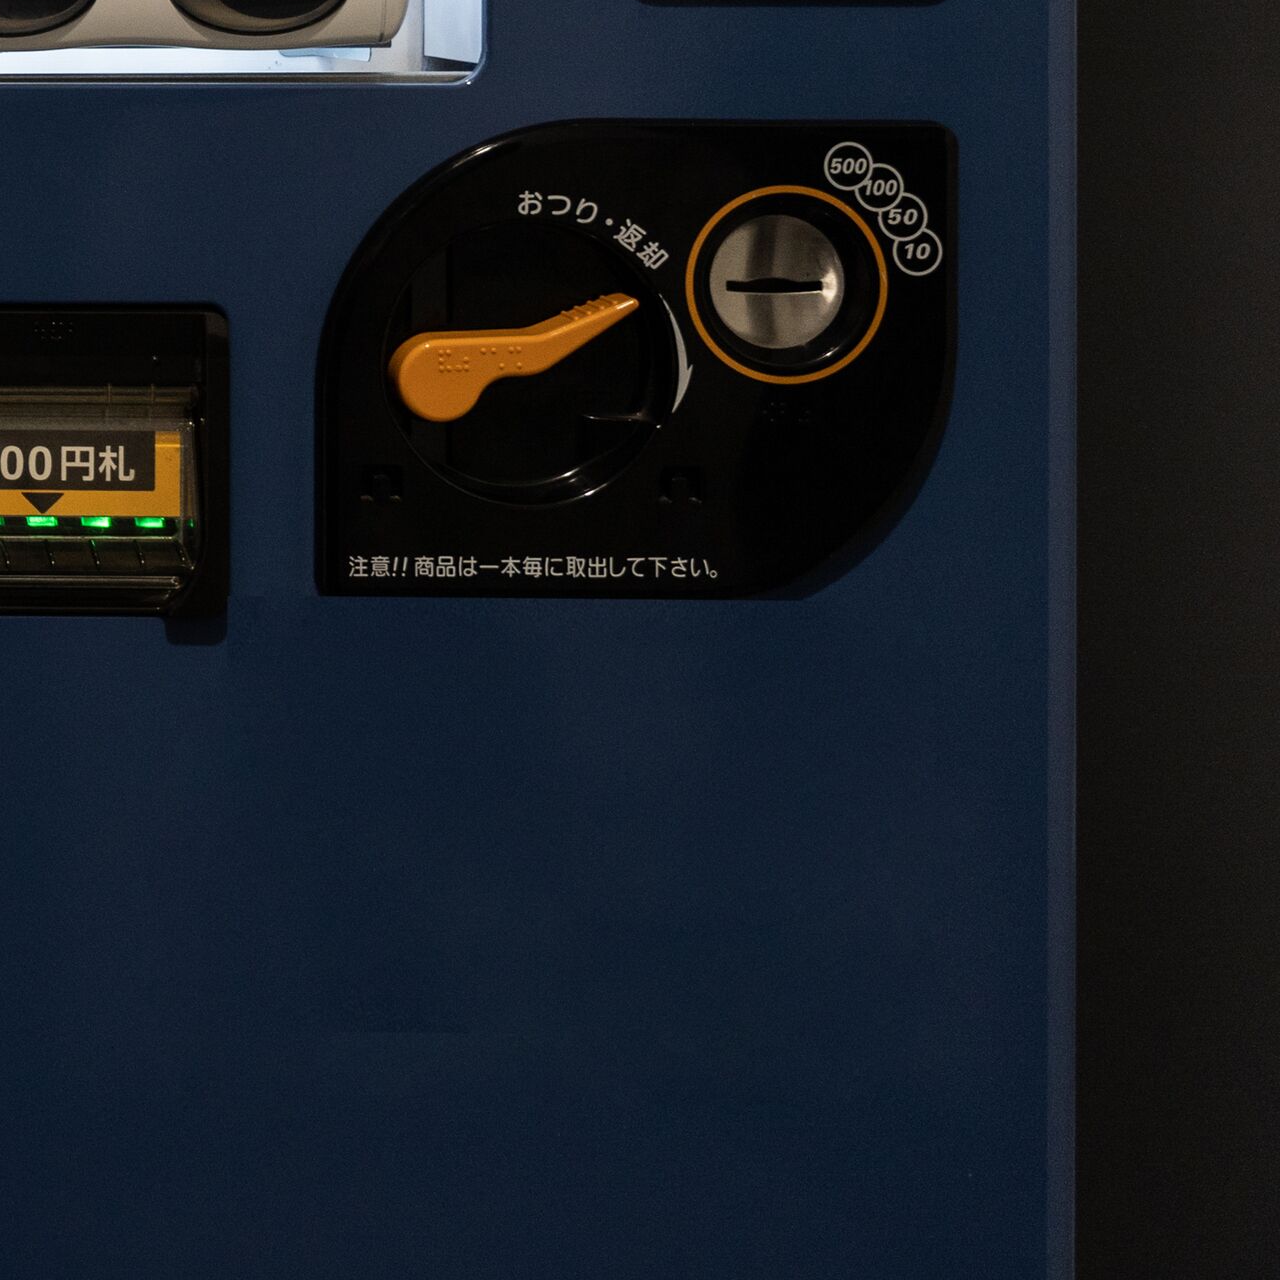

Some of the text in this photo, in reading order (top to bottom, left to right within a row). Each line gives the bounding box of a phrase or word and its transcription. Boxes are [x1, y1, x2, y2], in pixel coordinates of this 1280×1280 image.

[829, 158, 867, 175] 500
[864, 180, 897, 196] 100
[888, 209, 918, 225] 50
[517, 189, 669, 270] おつり・返却
[903, 243, 931, 260] 10
